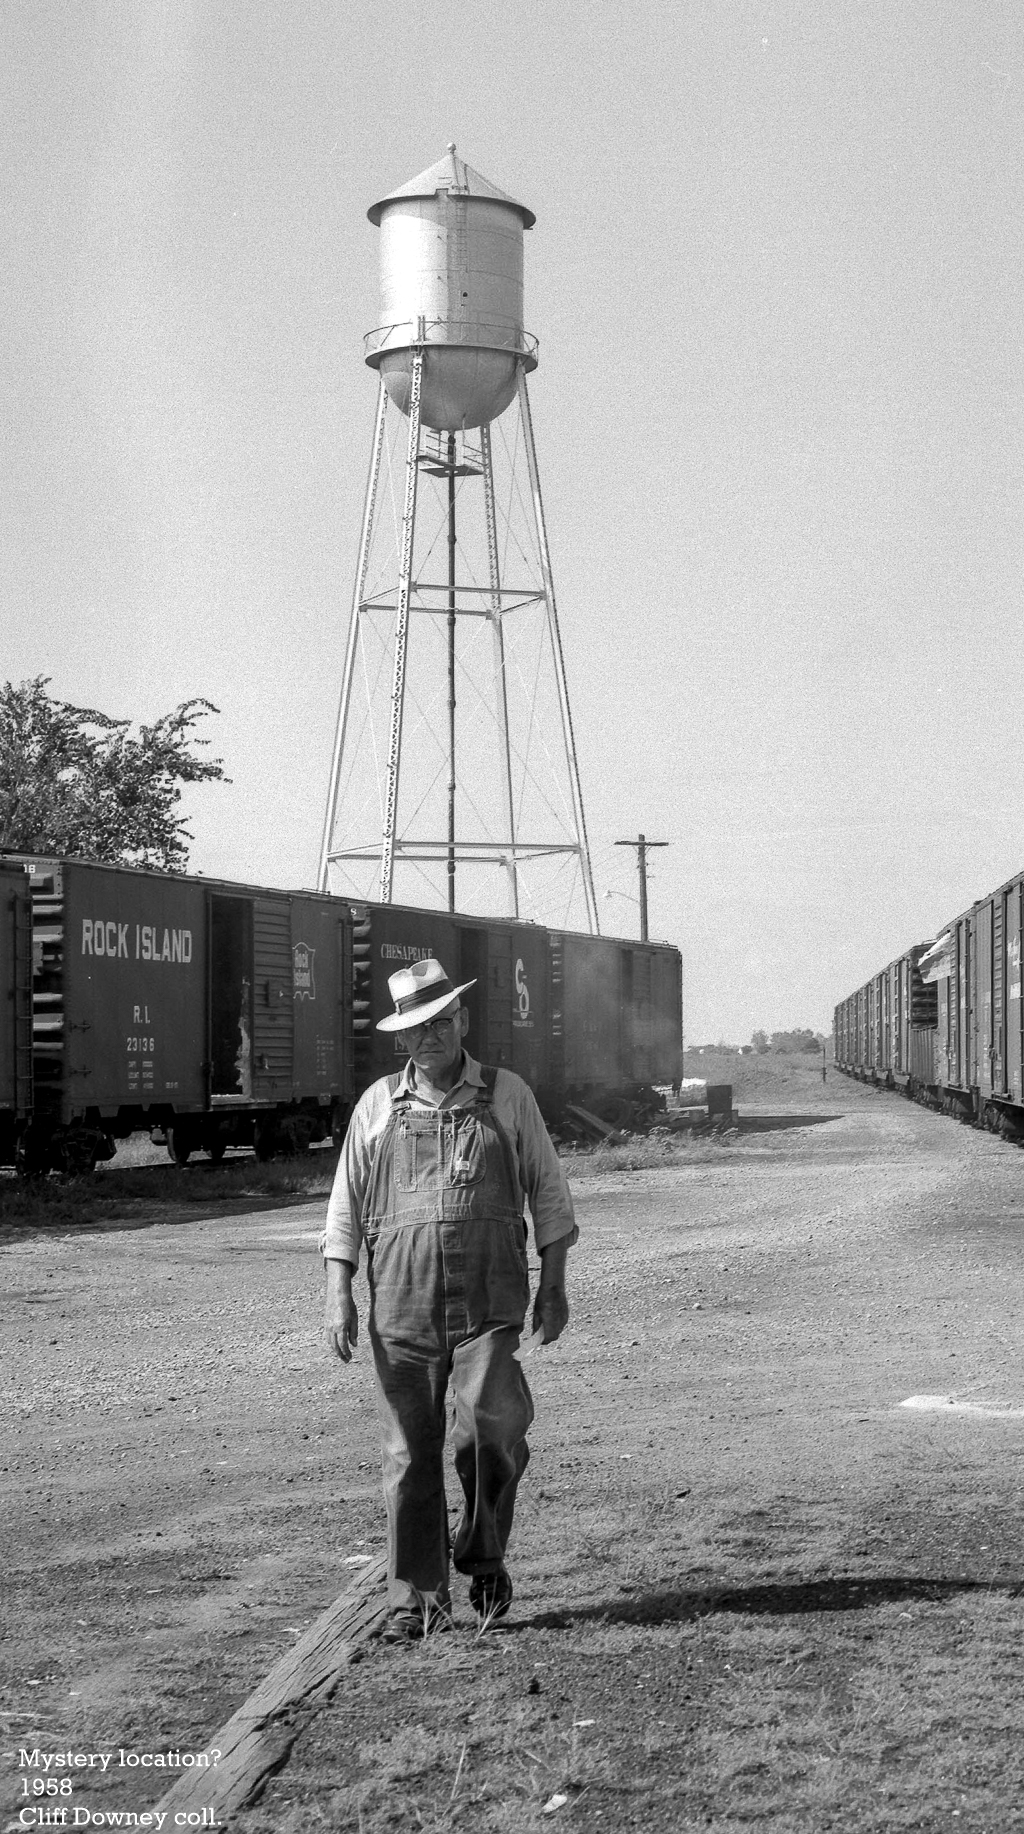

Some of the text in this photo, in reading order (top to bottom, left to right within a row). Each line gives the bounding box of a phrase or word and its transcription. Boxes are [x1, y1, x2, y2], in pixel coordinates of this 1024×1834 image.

[81, 919, 192, 963] ROCK ISLAND
[126, 1037, 155, 1052] 23136
